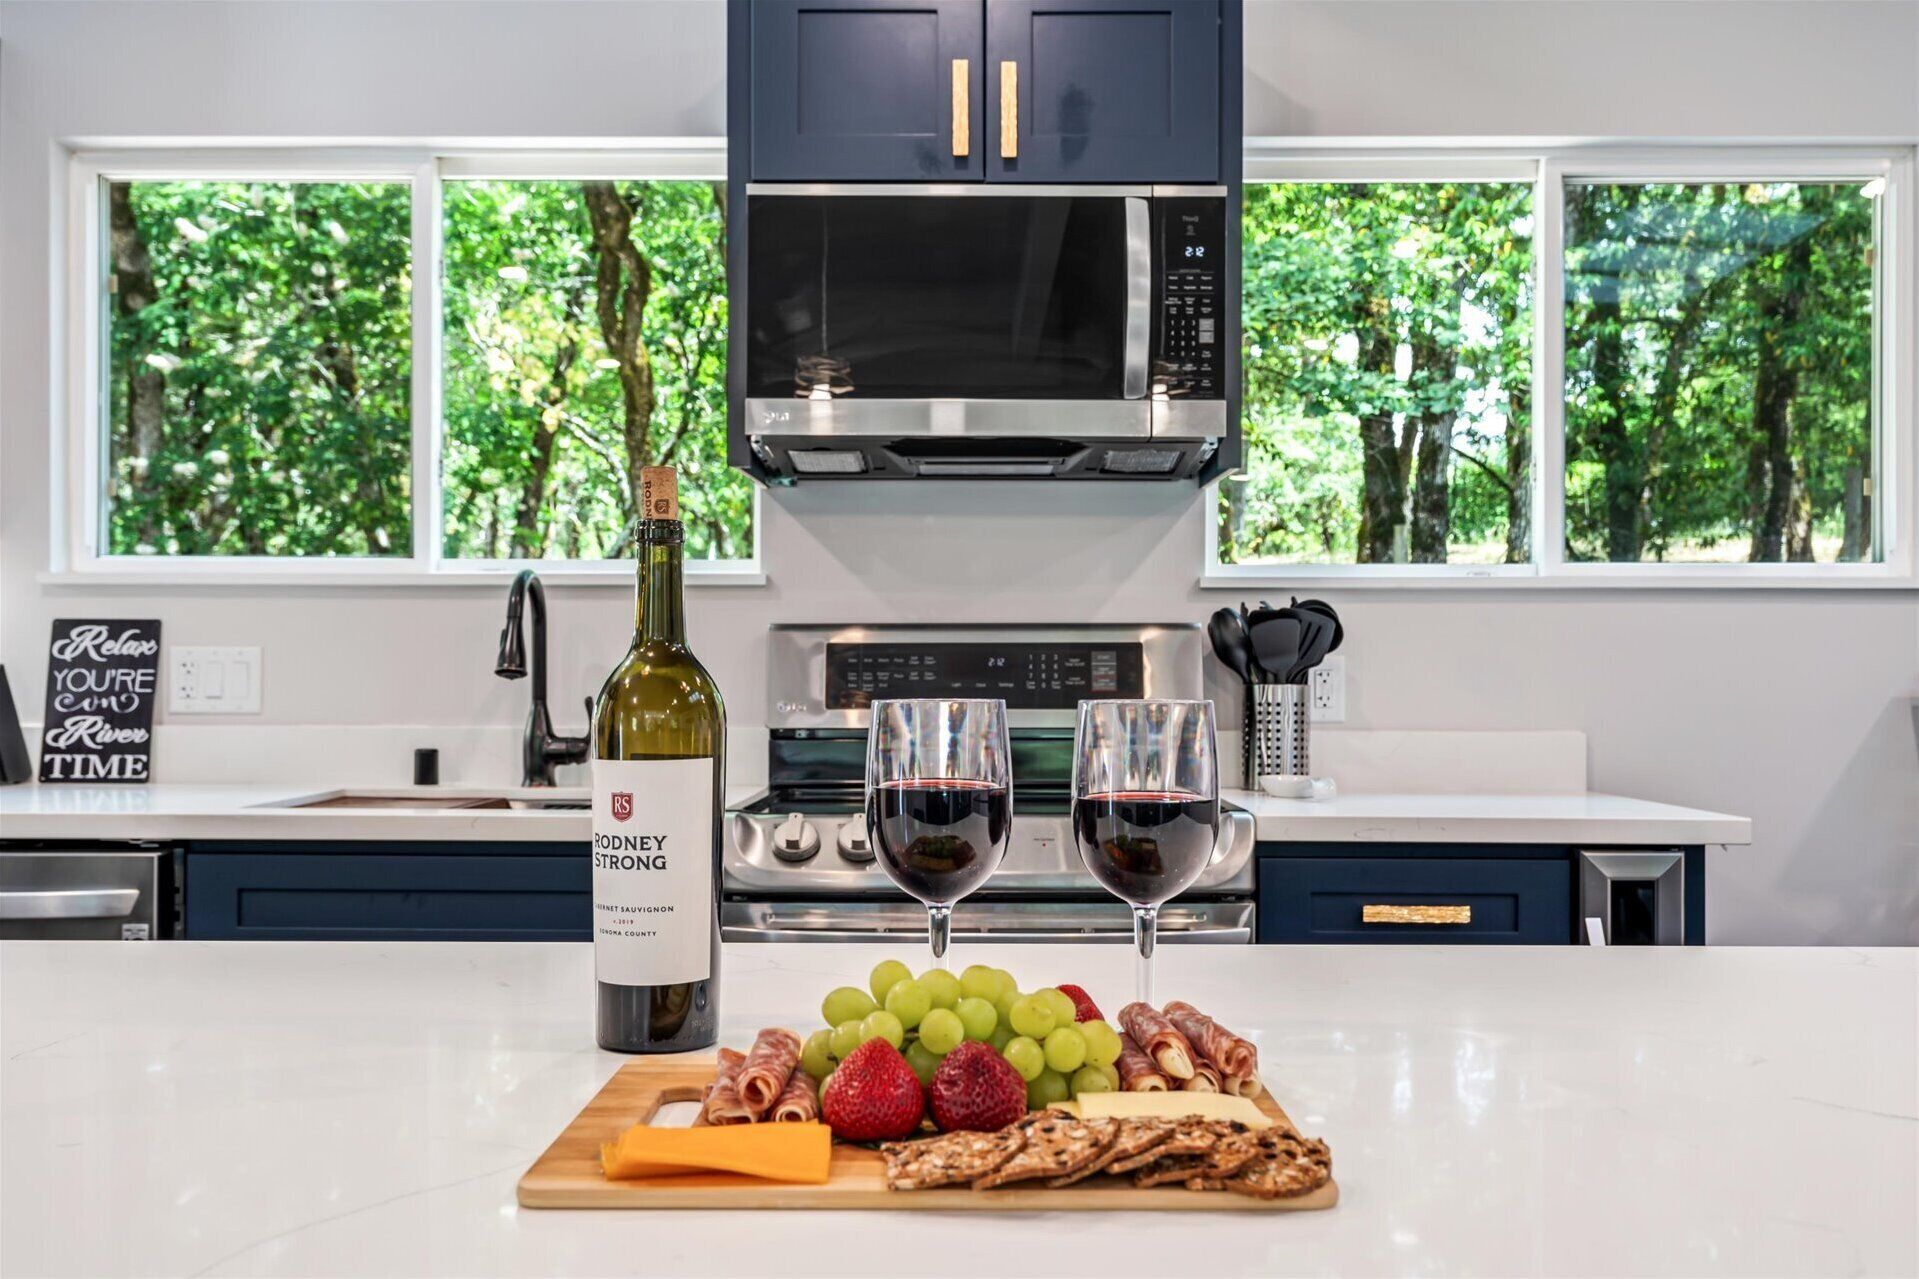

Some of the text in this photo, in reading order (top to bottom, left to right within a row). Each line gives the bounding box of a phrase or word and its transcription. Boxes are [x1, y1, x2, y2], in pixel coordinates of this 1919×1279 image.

[51, 624, 158, 662] Relax
[53, 667, 155, 693] YOU'RE
[45, 715, 149, 750] River
[44, 753, 148, 779] TIME
[614, 796, 630, 813] RS
[595, 832, 668, 851] RODNEY
[595, 851, 667, 870] STRONG
